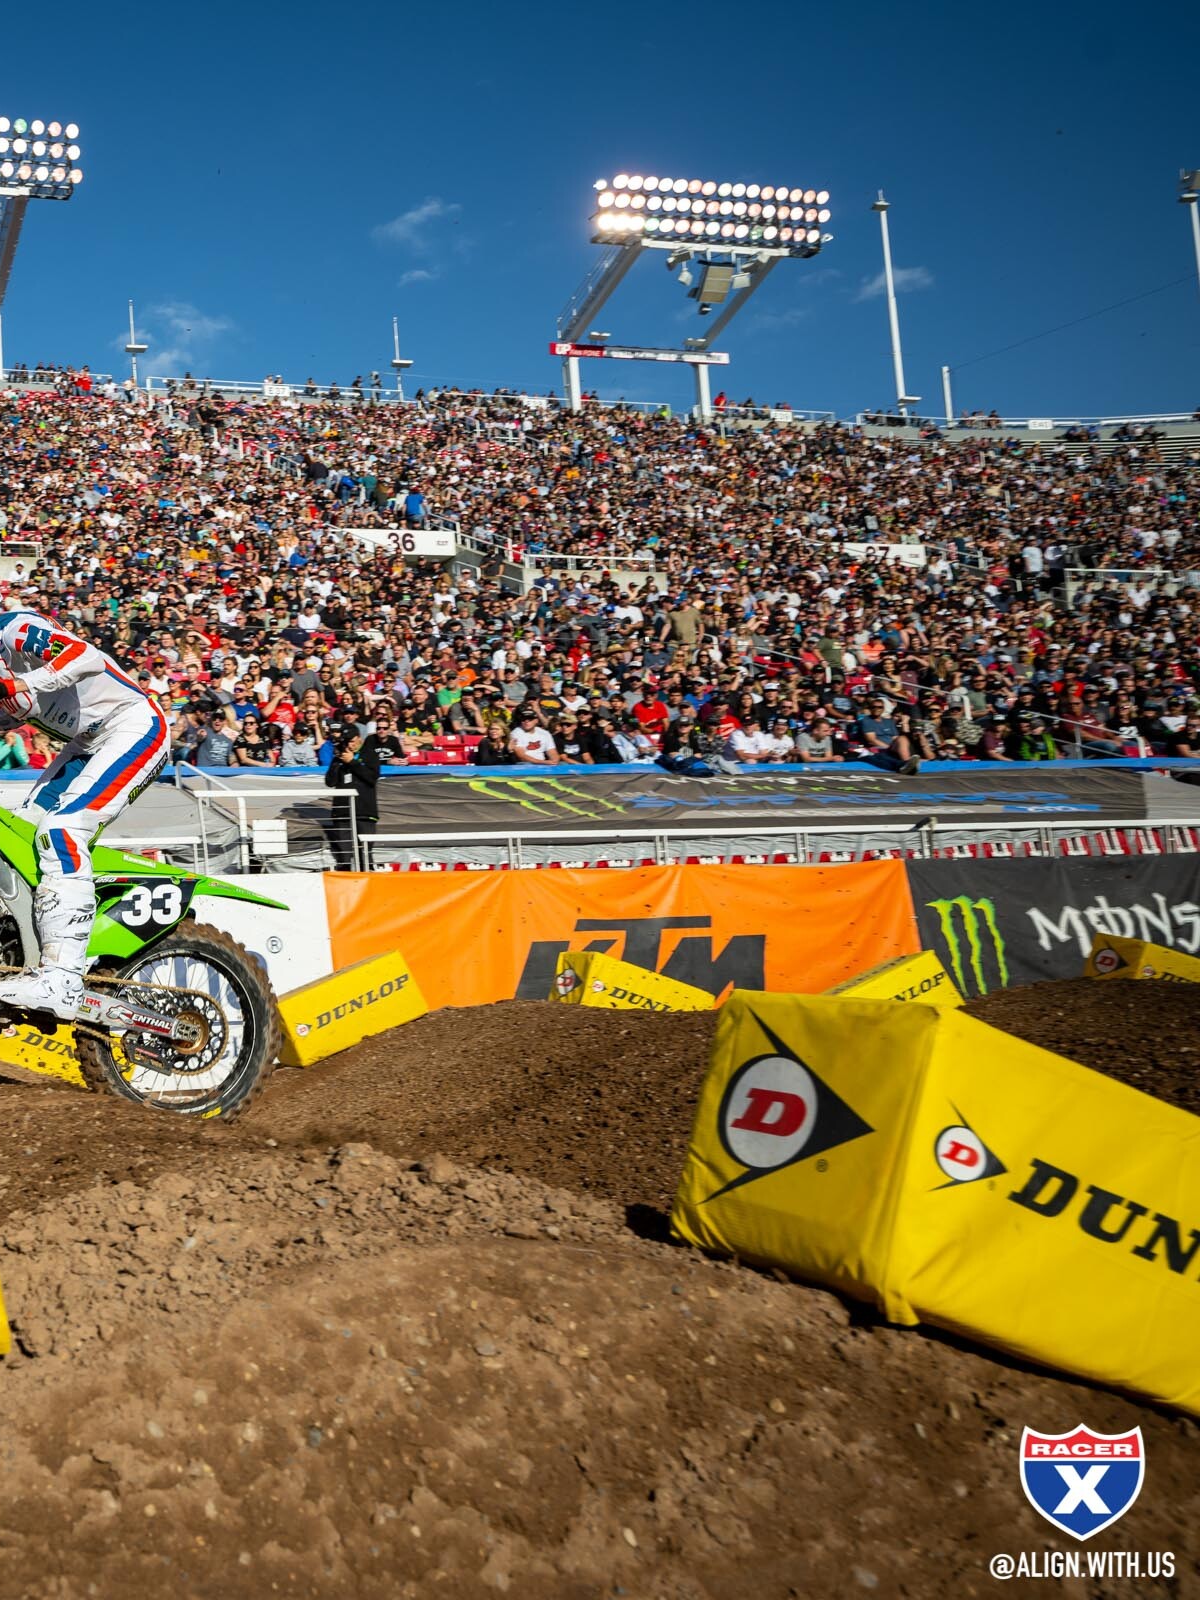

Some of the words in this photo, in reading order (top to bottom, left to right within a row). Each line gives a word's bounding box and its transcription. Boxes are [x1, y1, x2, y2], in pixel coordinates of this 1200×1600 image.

[388, 533, 416, 552] 36
[121, 884, 183, 926] 33
[514, 916, 765, 1001] KTM
[85, 997, 102, 1008] RK
[315, 973, 410, 1029] DUNLOP
[731, 1087, 807, 1137] D
[941, 1140, 980, 1169] D
